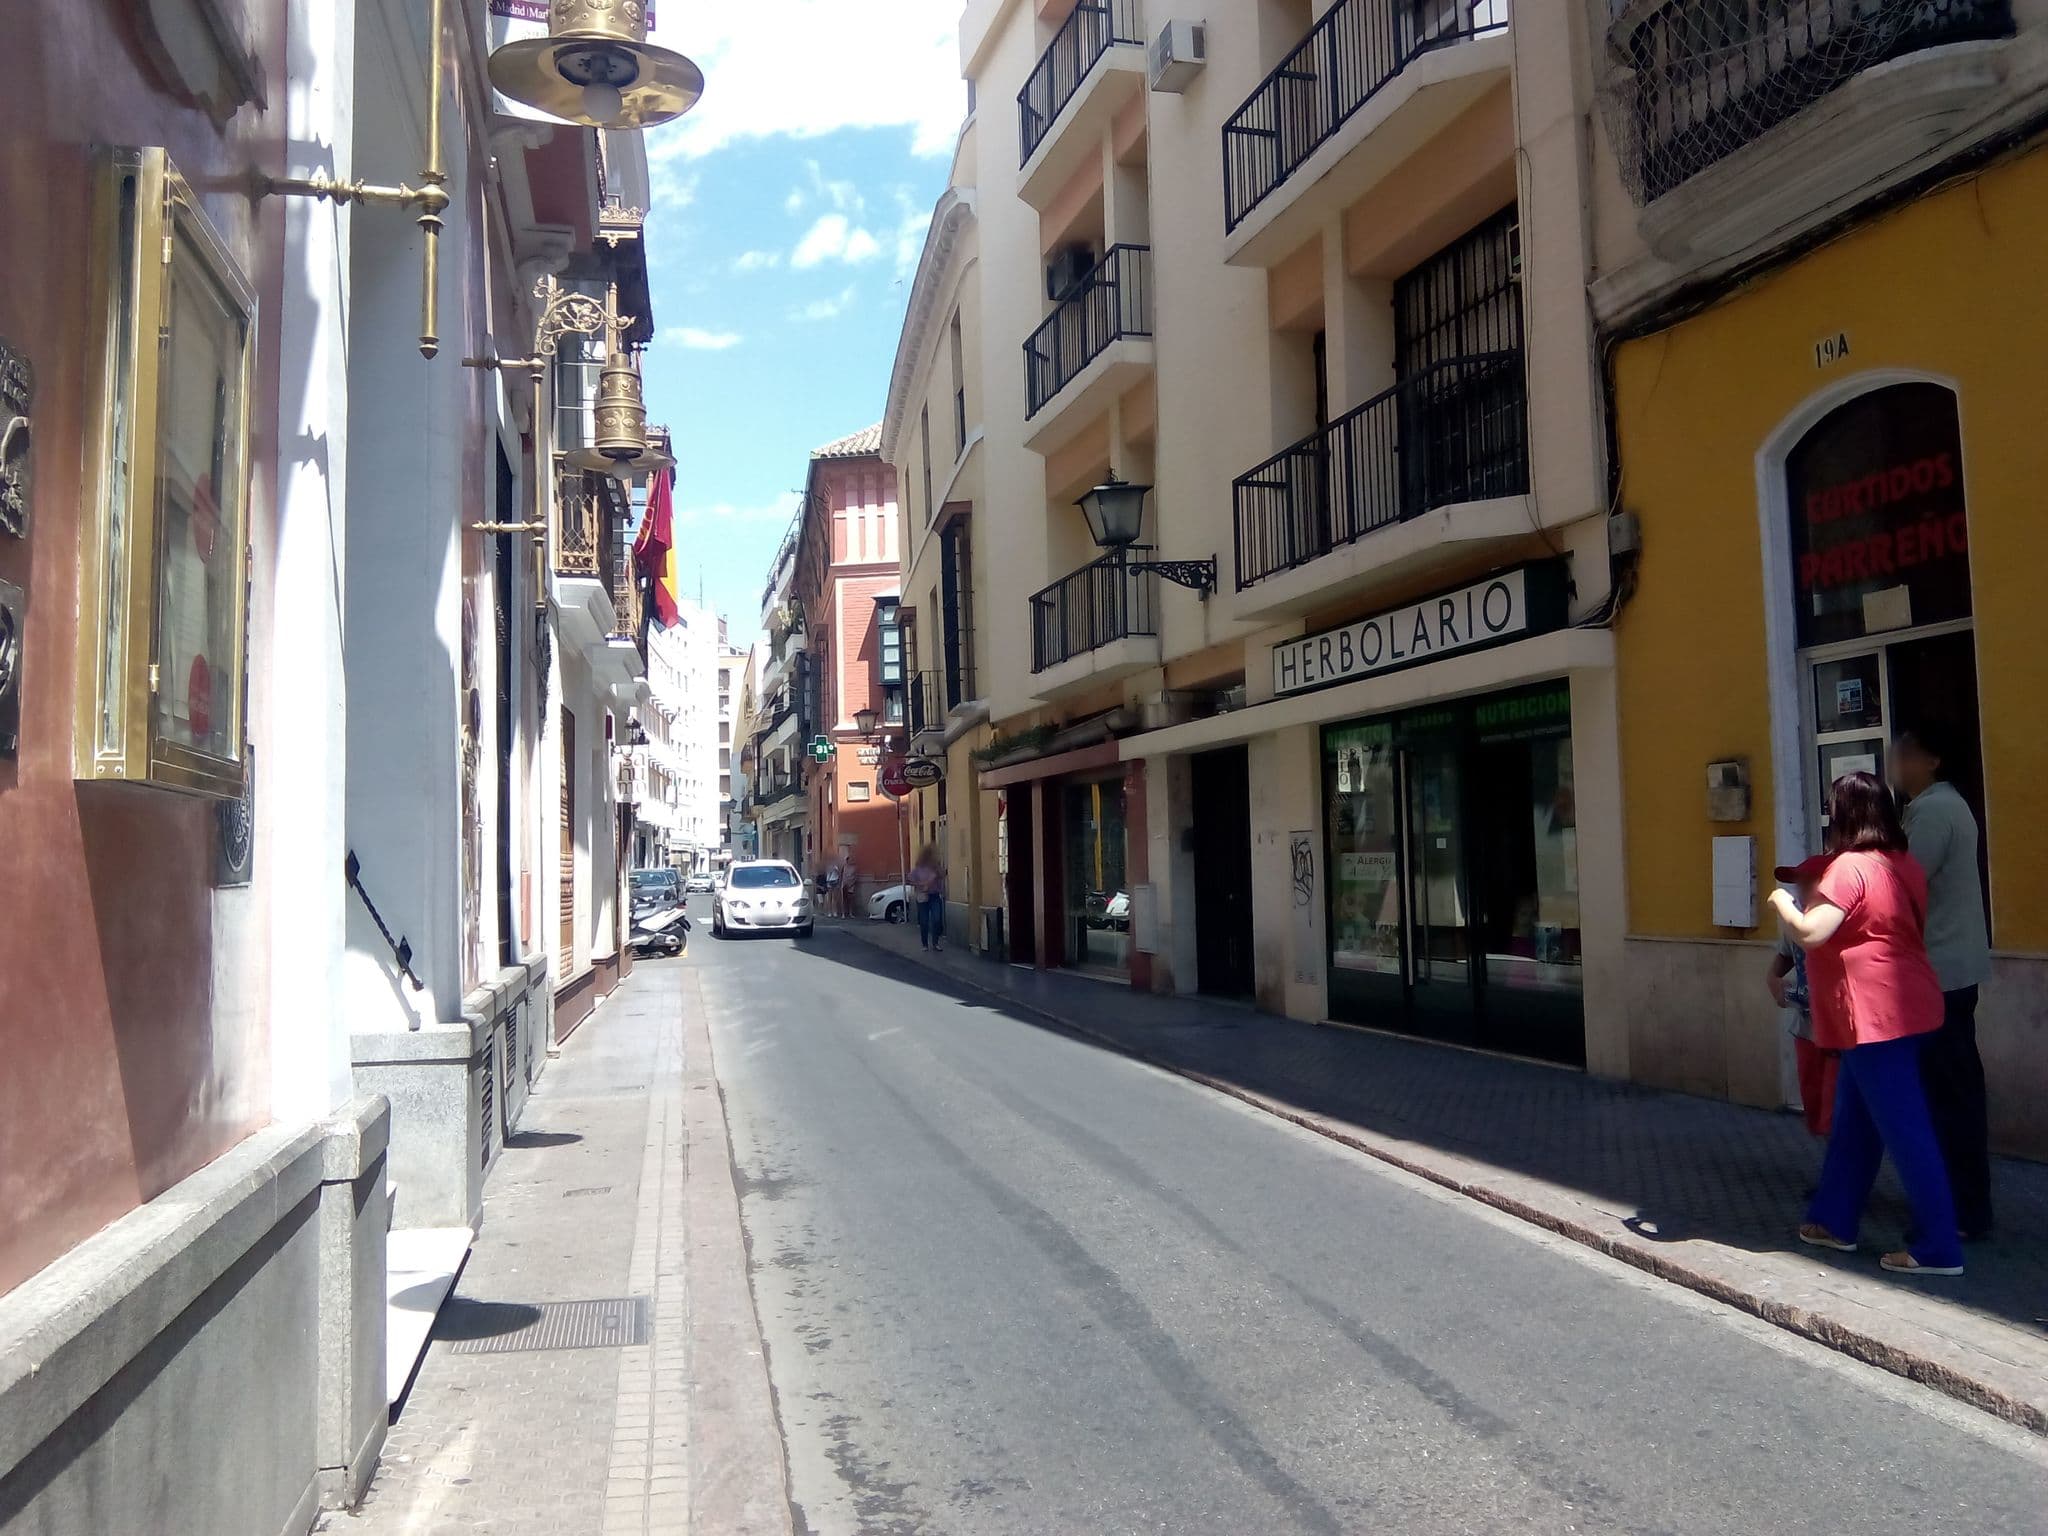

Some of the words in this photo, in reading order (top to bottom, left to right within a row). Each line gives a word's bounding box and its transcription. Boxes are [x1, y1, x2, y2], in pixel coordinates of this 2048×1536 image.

[1816, 333, 1849, 369] 19A
[1806, 453, 1953, 524] CURTIDOS
[1281, 581, 1512, 689] HERBOLARIO
